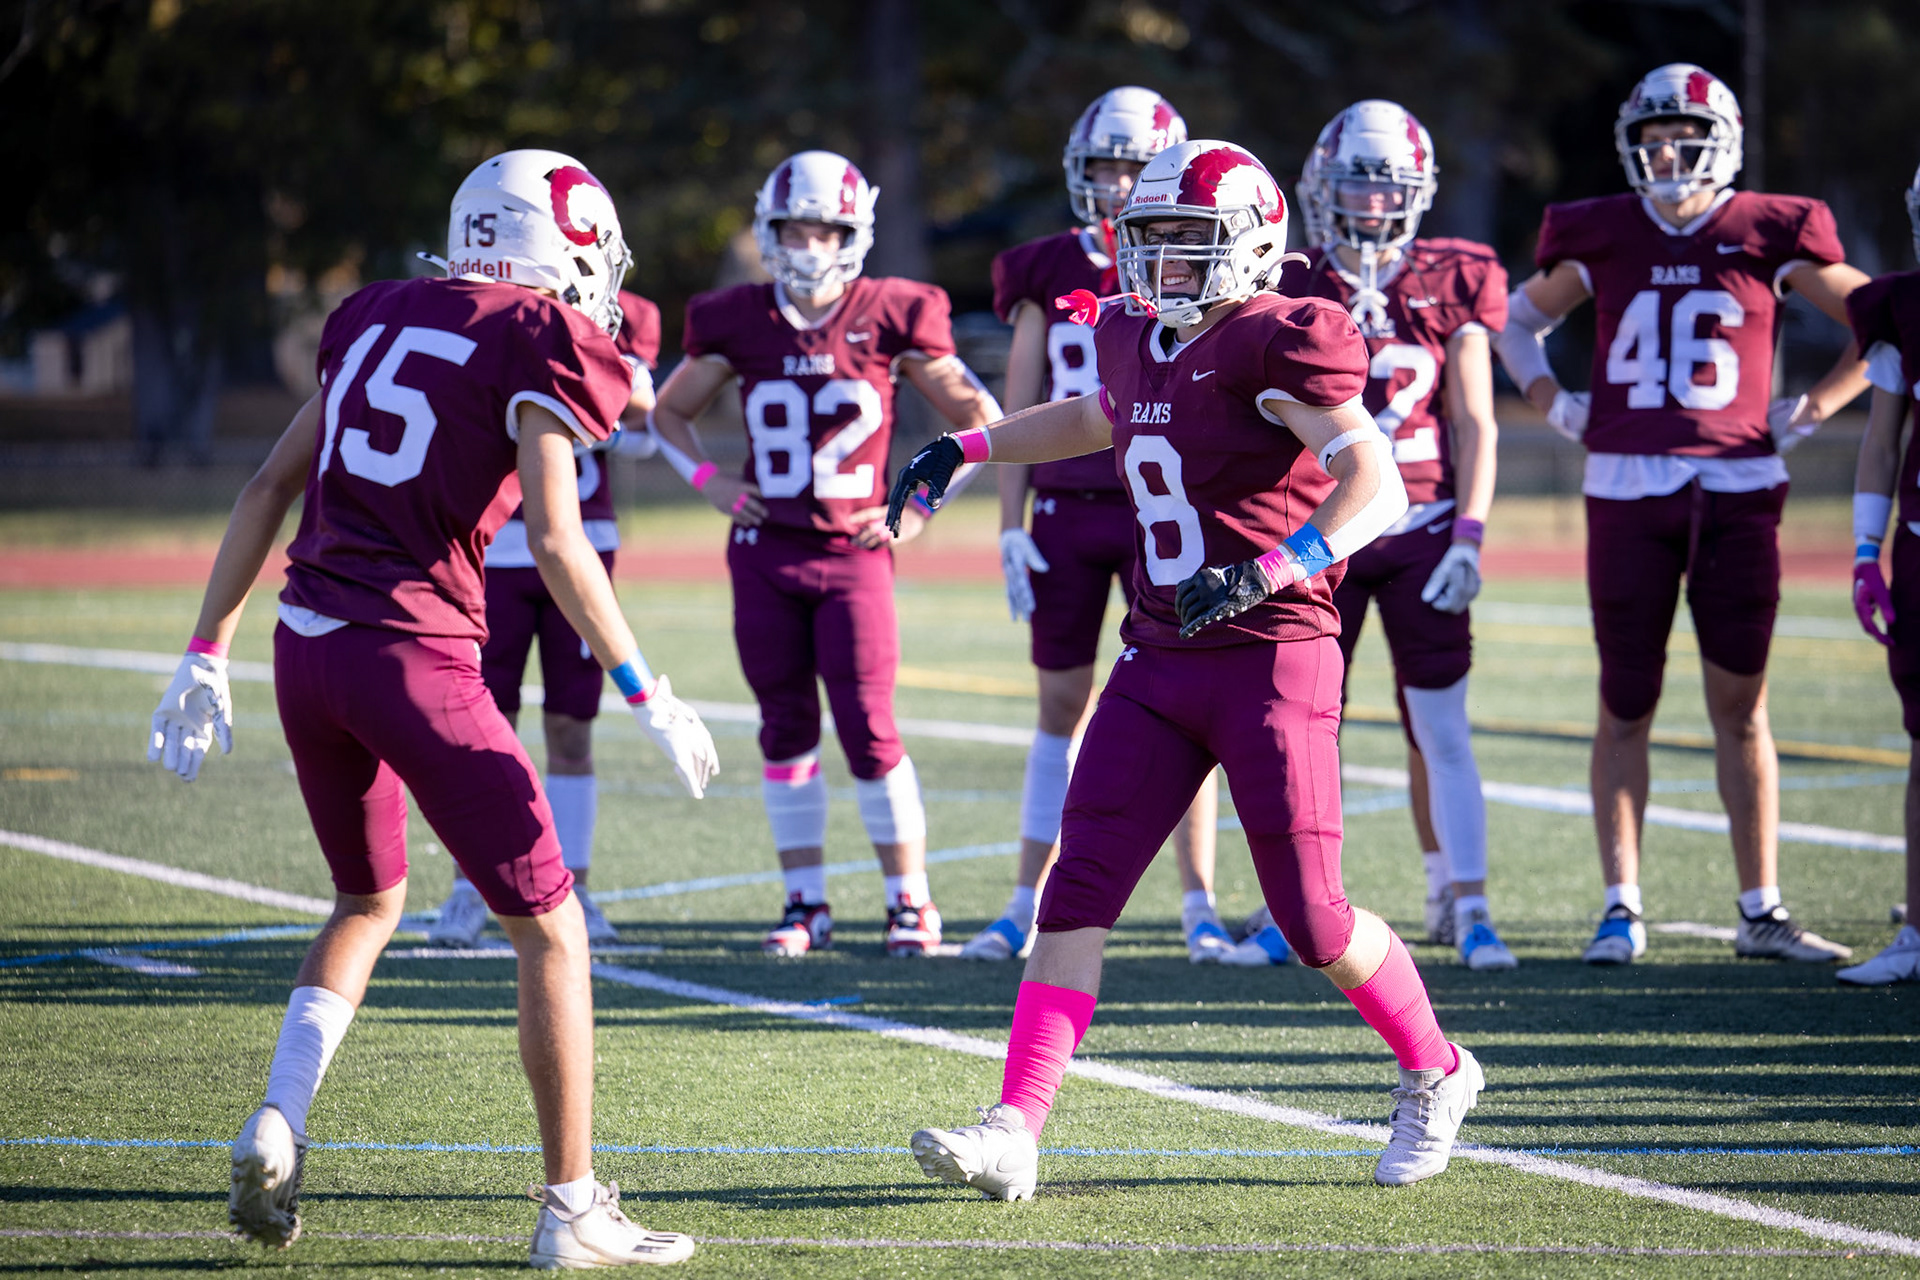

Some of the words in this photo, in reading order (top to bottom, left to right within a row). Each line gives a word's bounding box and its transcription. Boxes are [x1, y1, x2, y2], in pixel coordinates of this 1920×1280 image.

[464, 213, 497, 248] 15
[449, 258, 512, 279] Riddell
[1651, 266, 1700, 285] RAMS
[783, 354, 835, 375] RAMS
[1606, 289, 1744, 410] 46
[318, 324, 478, 487] 15
[1130, 401, 1171, 424] RAMS
[746, 379, 883, 499] 82
[1124, 435, 1205, 586] 8
